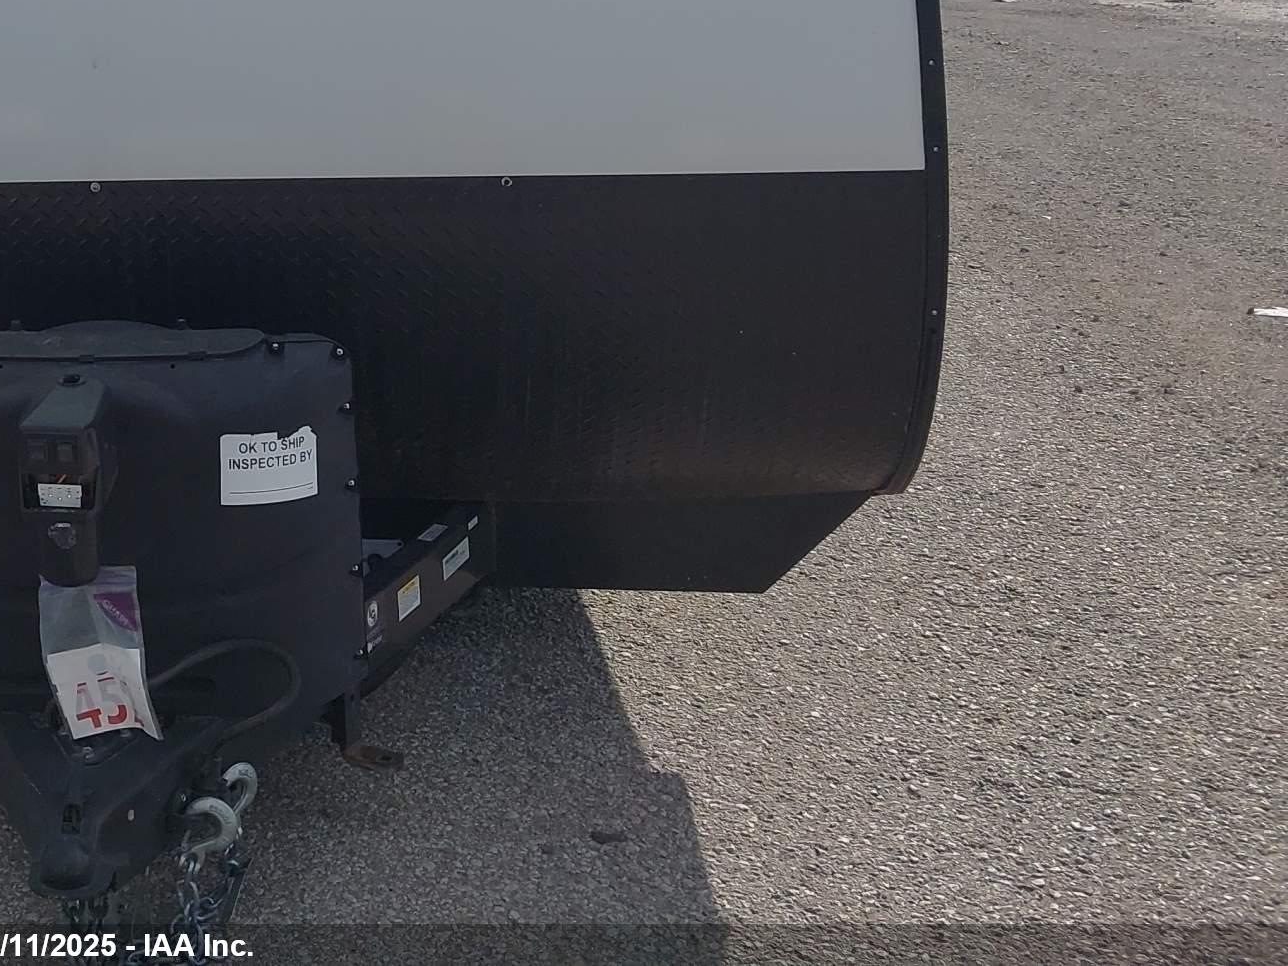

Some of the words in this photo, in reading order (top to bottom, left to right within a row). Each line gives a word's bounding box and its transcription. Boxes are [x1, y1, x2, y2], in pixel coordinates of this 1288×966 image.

[238, 442, 258, 454] OK
[261, 440, 278, 453] TO
[280, 435, 305, 451] SHIP
[228, 453, 297, 470] INSPECTED
[299, 448, 313, 463] BY
